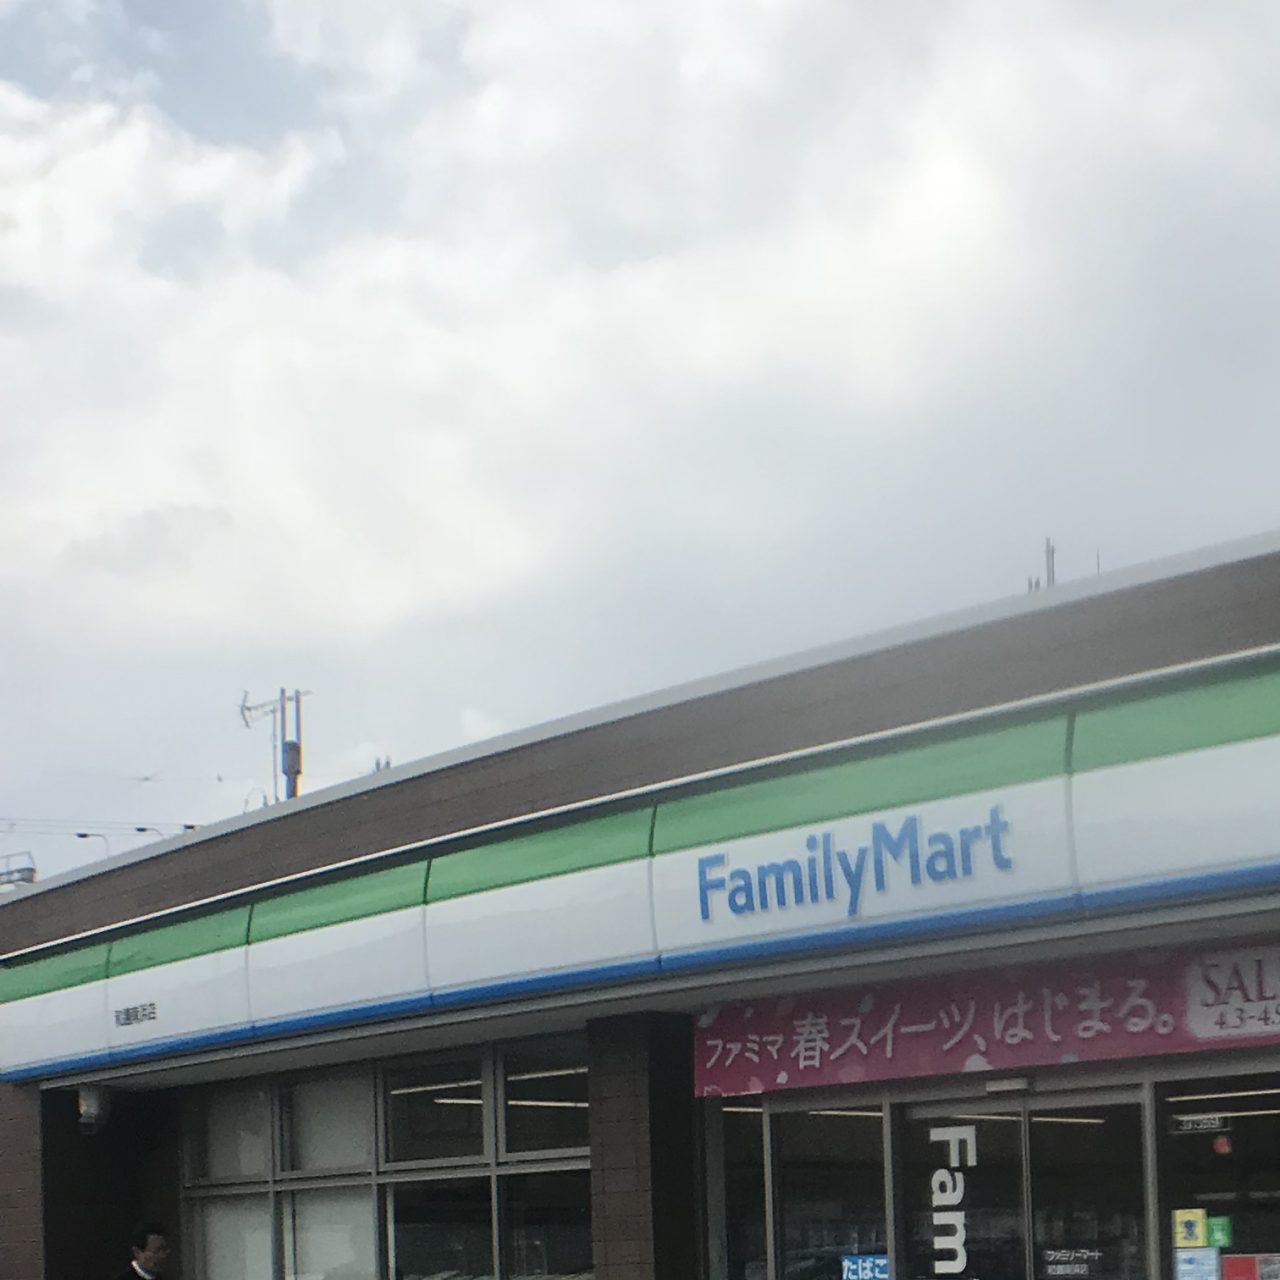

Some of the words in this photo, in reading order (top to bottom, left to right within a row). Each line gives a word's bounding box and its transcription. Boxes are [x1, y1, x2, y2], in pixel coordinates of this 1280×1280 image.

[698, 804, 1013, 920] FamilyMart
[706, 1034, 784, 1069] ファミマ
[842, 1258, 888, 1280] たばこ
